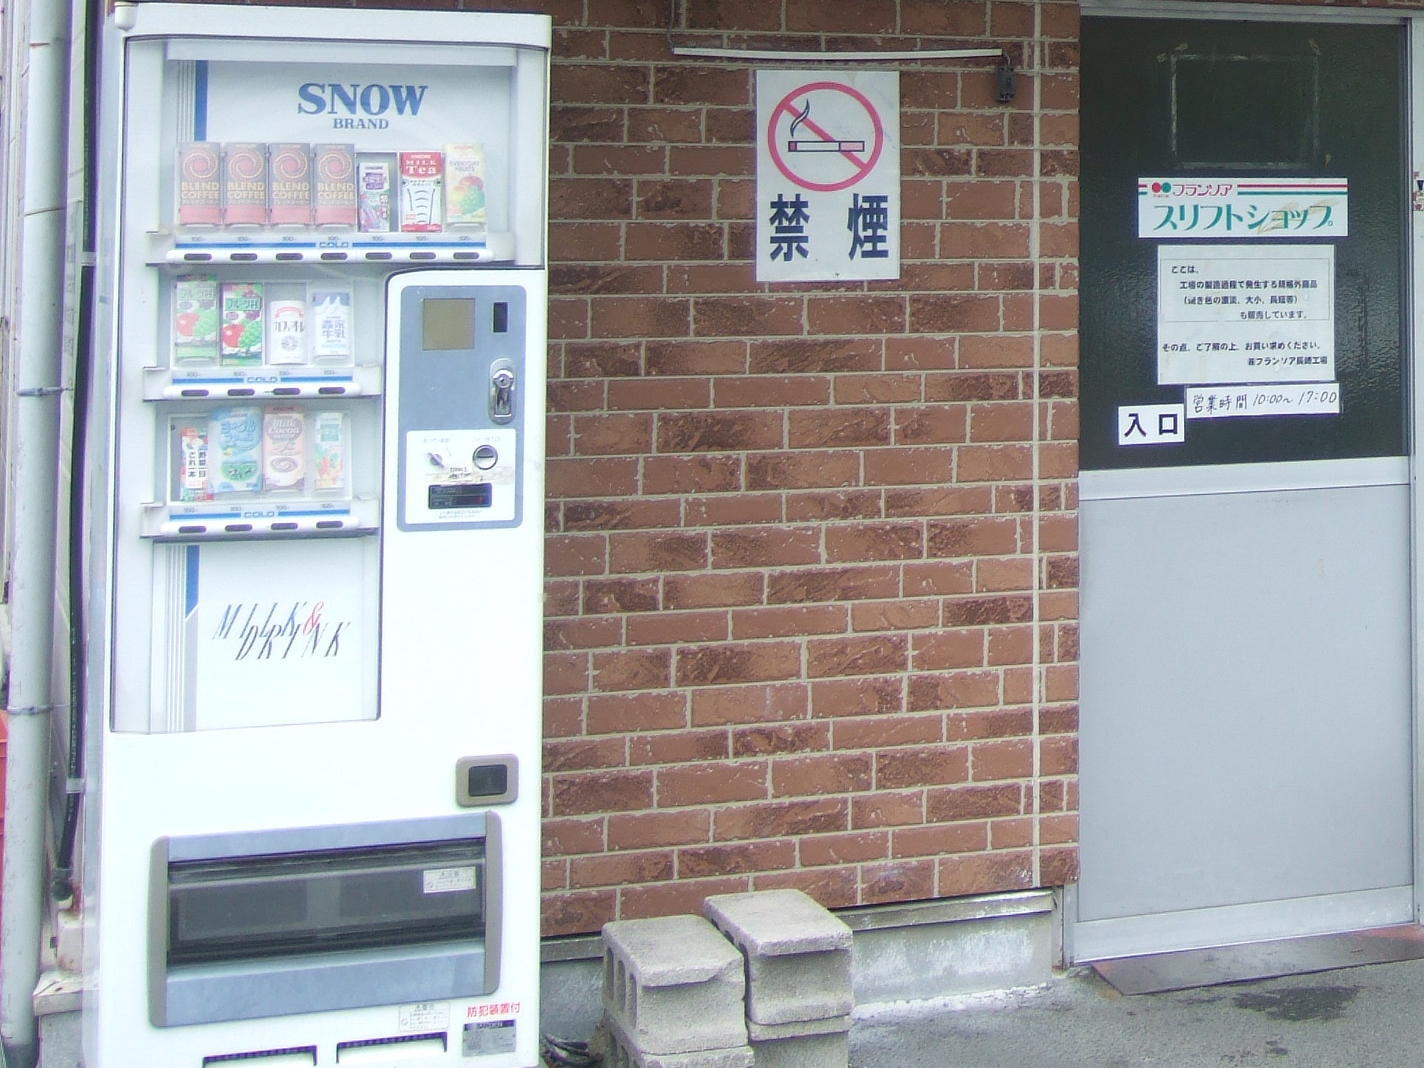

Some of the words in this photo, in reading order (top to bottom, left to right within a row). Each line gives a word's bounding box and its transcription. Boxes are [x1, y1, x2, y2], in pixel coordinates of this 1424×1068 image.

[297, 82, 429, 117] SNOW
[333, 117, 389, 130] BRAND
[406, 165, 437, 174] Tea
[1172, 184, 1233, 197] フランソア
[769, 192, 890, 262] 禁煙
[1152, 203, 1334, 232] スリフトショップ
[246, 376, 279, 384] COLD
[1192, 393, 1248, 415] 営業時間
[1298, 390, 1338, 406] 17:00
[1123, 412, 1179, 438] 入口
[243, 510, 276, 518] COLD
[467, 1000, 522, 1019] 防犯装置付
